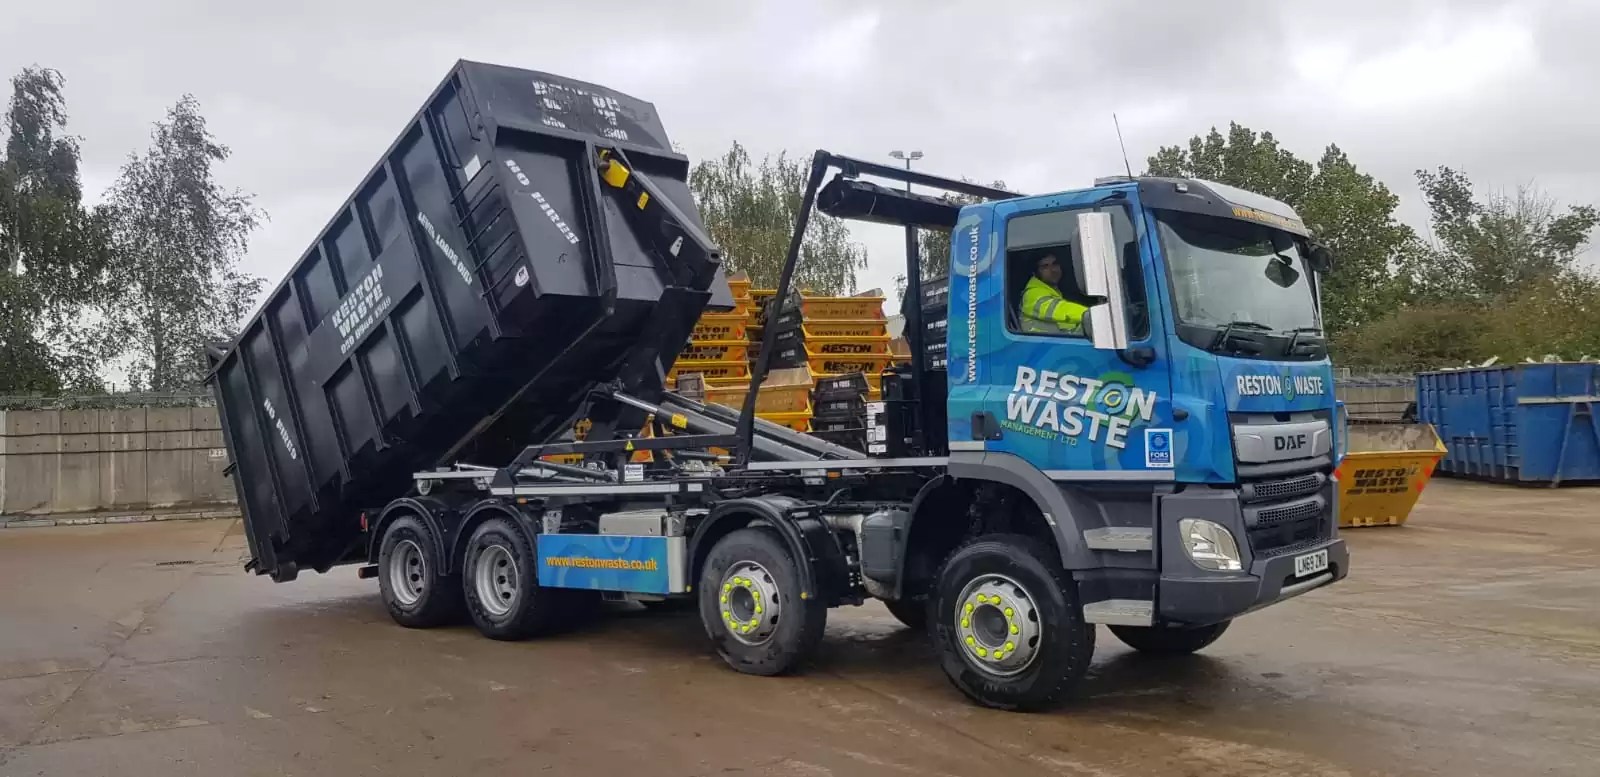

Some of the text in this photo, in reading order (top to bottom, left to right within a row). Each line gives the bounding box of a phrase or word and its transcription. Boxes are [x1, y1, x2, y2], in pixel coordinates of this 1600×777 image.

[504, 159, 530, 186] NO
[332, 263, 383, 329] RESTON
[967, 225, 980, 383] www.restonwaste.co.uk
[338, 283, 383, 339] WASTE
[821, 344, 872, 353] RESTON
[823, 361, 874, 371] RESTON
[1012, 366, 1157, 422] RESTON
[1236, 375, 1324, 395] RESTON WASTE
[1000, 420, 1077, 446] MANAGEMENT LTD
[1006, 393, 1131, 449] WASTE
[1274, 434, 1307, 451] DAF
[1355, 477, 1409, 487] WASTE
[545, 556, 658, 572] www.restonwaste.co.uk
